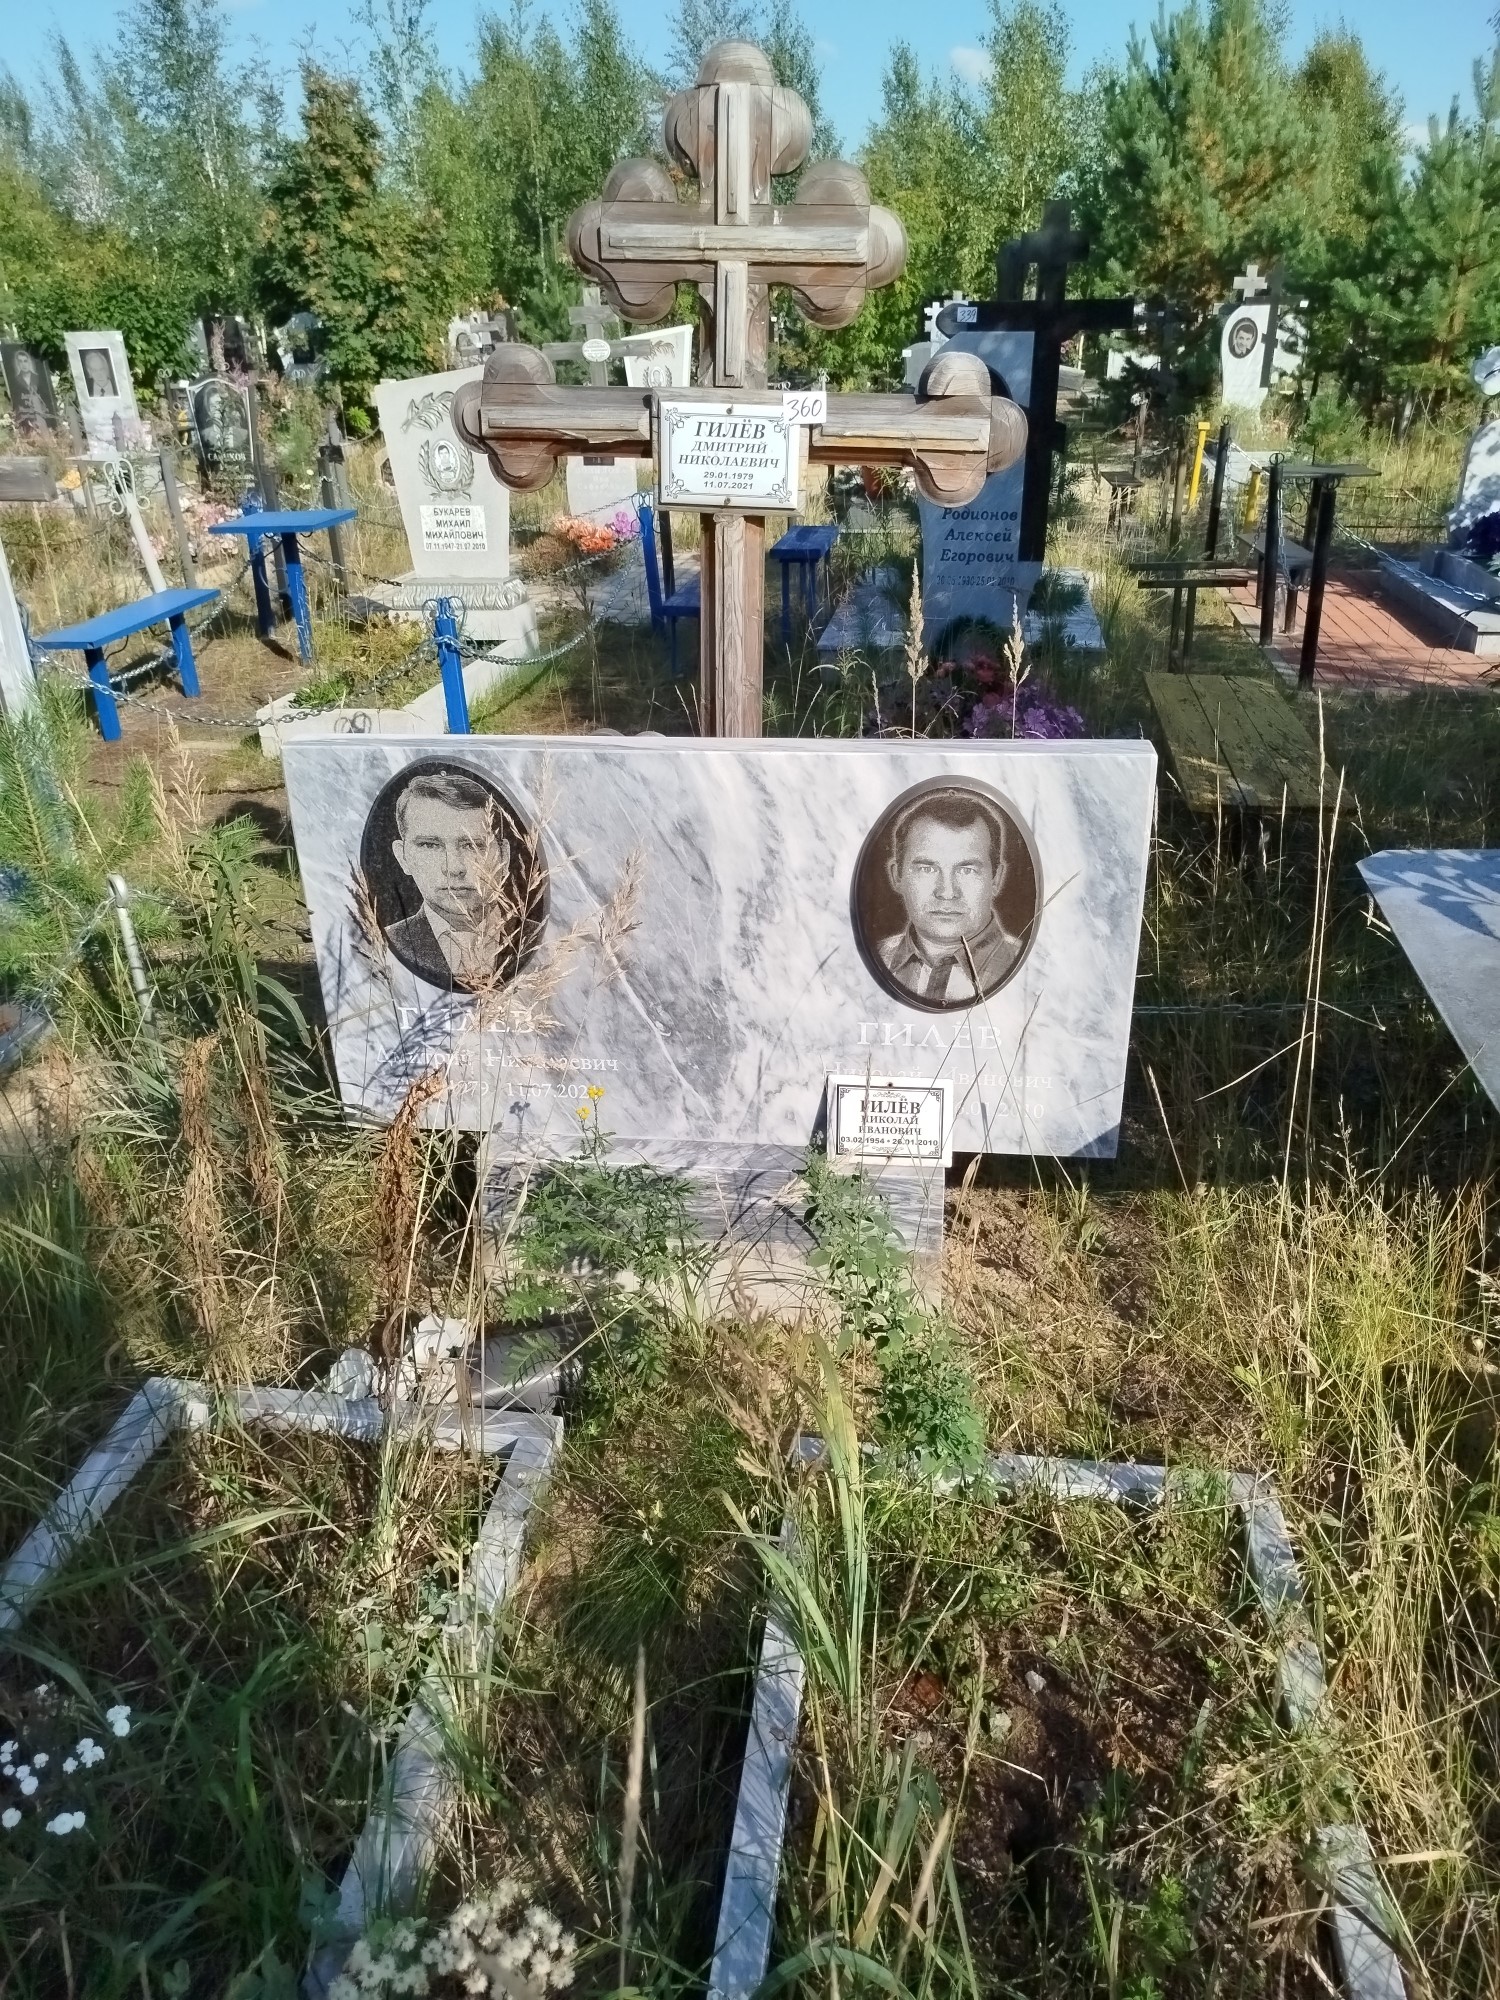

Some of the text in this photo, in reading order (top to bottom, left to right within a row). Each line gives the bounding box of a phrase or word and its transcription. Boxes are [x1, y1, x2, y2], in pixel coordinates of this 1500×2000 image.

[787, 397, 822, 422] 360
[694, 419, 766, 439] ГИЛЁВ
[691, 441, 768, 454] ДМИТРИЙ
[678, 454, 780, 469] НИКОЛАЕВИЧ
[703, 471, 754, 481] 29.01.1979
[703, 481, 754, 490] 11.07.2021
[433, 507, 471, 517] БУКАРЕВ
[942, 506, 1018, 521] Родионов
[435, 519, 471, 528] МИХАИЛ
[425, 529, 484, 540] МИХАЙЛОВИЧ
[944, 528, 1013, 542] Алексей
[940, 548, 1015, 566] Егорович
[857, 1021, 1002, 1050] ГИЛЁВ
[860, 1098, 921, 1114] ГИЛЁВ
